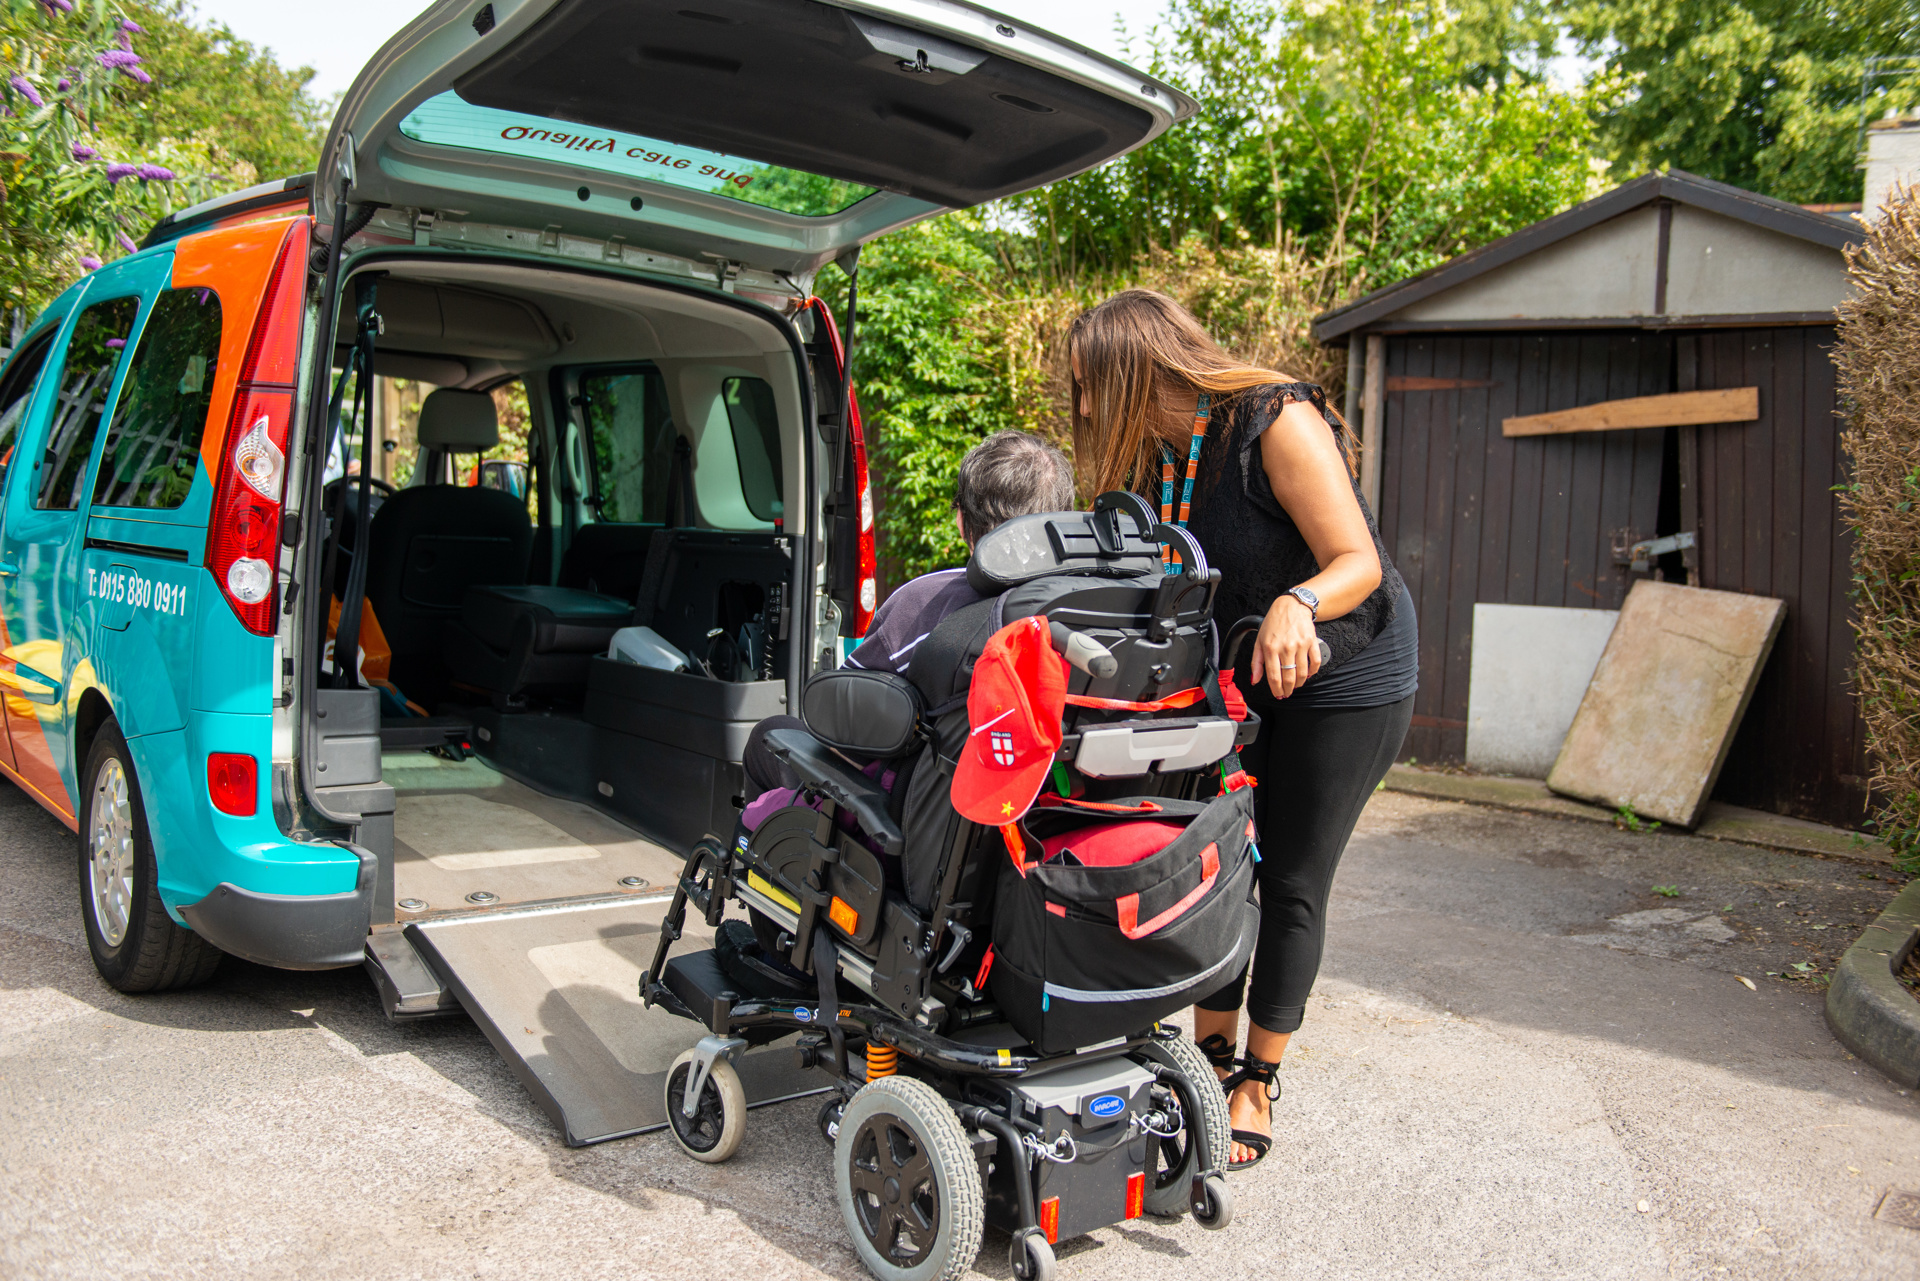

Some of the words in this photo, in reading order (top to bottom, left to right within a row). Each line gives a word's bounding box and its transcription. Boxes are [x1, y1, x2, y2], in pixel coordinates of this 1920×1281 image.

[88, 568, 97, 596] T:
[99, 571, 125, 602] 0115
[127, 576, 151, 608] 880
[154, 581, 186, 616] 0911
